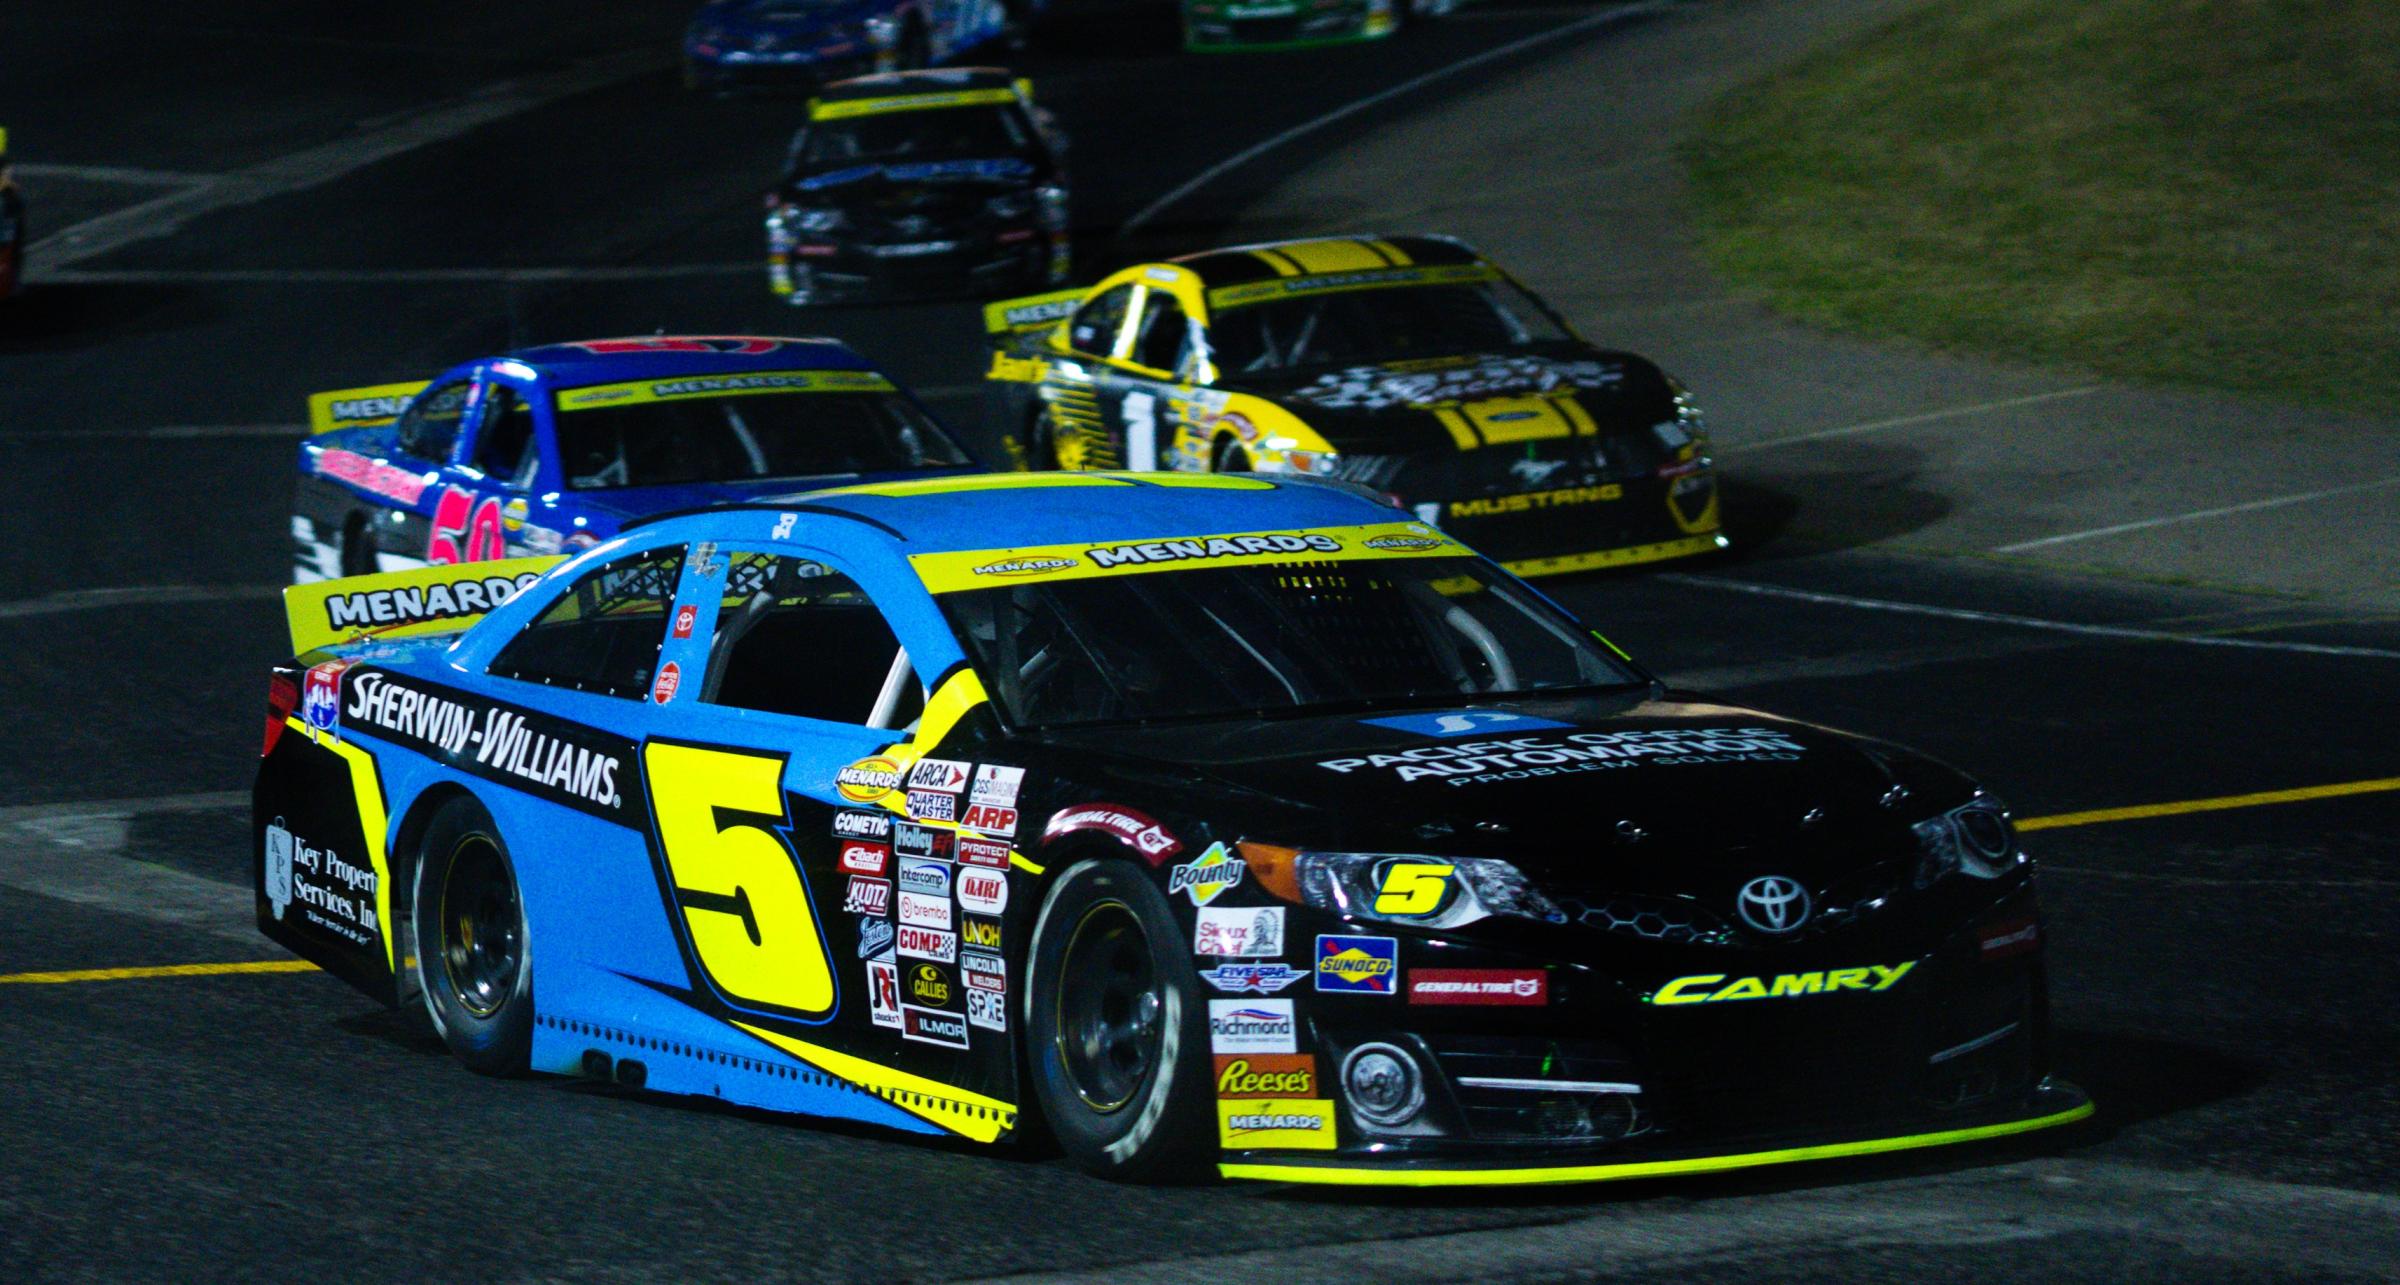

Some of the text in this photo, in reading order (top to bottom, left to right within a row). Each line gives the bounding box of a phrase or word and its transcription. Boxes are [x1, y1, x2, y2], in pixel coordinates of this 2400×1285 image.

[654, 377, 810, 397] MENARDS
[1449, 483, 1624, 518] MUSTANG
[1088, 534, 1342, 569] MENARDS
[1362, 538, 1442, 550] MENARDS
[972, 556, 1079, 577] MENARDS
[1317, 727, 1792, 773] PACIFIC OFFICE
[1394, 736, 1808, 783] AUTOMATION
[835, 765, 902, 792] MENARDS
[909, 762, 950, 788] ARCA
[1447, 751, 1801, 788] PROBLEM SOLVED
[906, 792, 953, 809] QUARTER
[912, 803, 953, 820] MASTER
[834, 811, 889, 837] COMETIC
[962, 804, 1017, 831] ARP
[896, 825, 934, 856] Holley
[960, 842, 1009, 858] PYROTECT
[294, 835, 322, 875] Key
[843, 846, 885, 869] Eibach
[644, 741, 835, 1013] 5
[901, 865, 944, 888] Intercomp
[1171, 860, 1245, 892] Bounty
[294, 872, 357, 922] Services,
[850, 881, 888, 907] KLOTZ
[1373, 863, 1458, 915] 5
[913, 901, 948, 920] brembo
[900, 929, 941, 952] COMP
[963, 920, 1001, 947] UNOH
[1199, 921, 1248, 939] Siux
[1198, 938, 1243, 954] Chef
[962, 955, 1000, 973] LINCOLN
[1219, 966, 1288, 977] FIVE STAR
[1321, 957, 1390, 973] SUNOCO
[914, 979, 948, 1000] CALLIES
[1414, 982, 1480, 993] GENERAL
[1481, 982, 1513, 993] TIRE
[1651, 961, 1917, 1006] CAMRY
[920, 1017, 966, 1038] ILMOR
[1211, 1014, 1291, 1035] Richmond
[1218, 1059, 1312, 1094] Reese's
[1228, 1113, 1323, 1131] MENARDS
